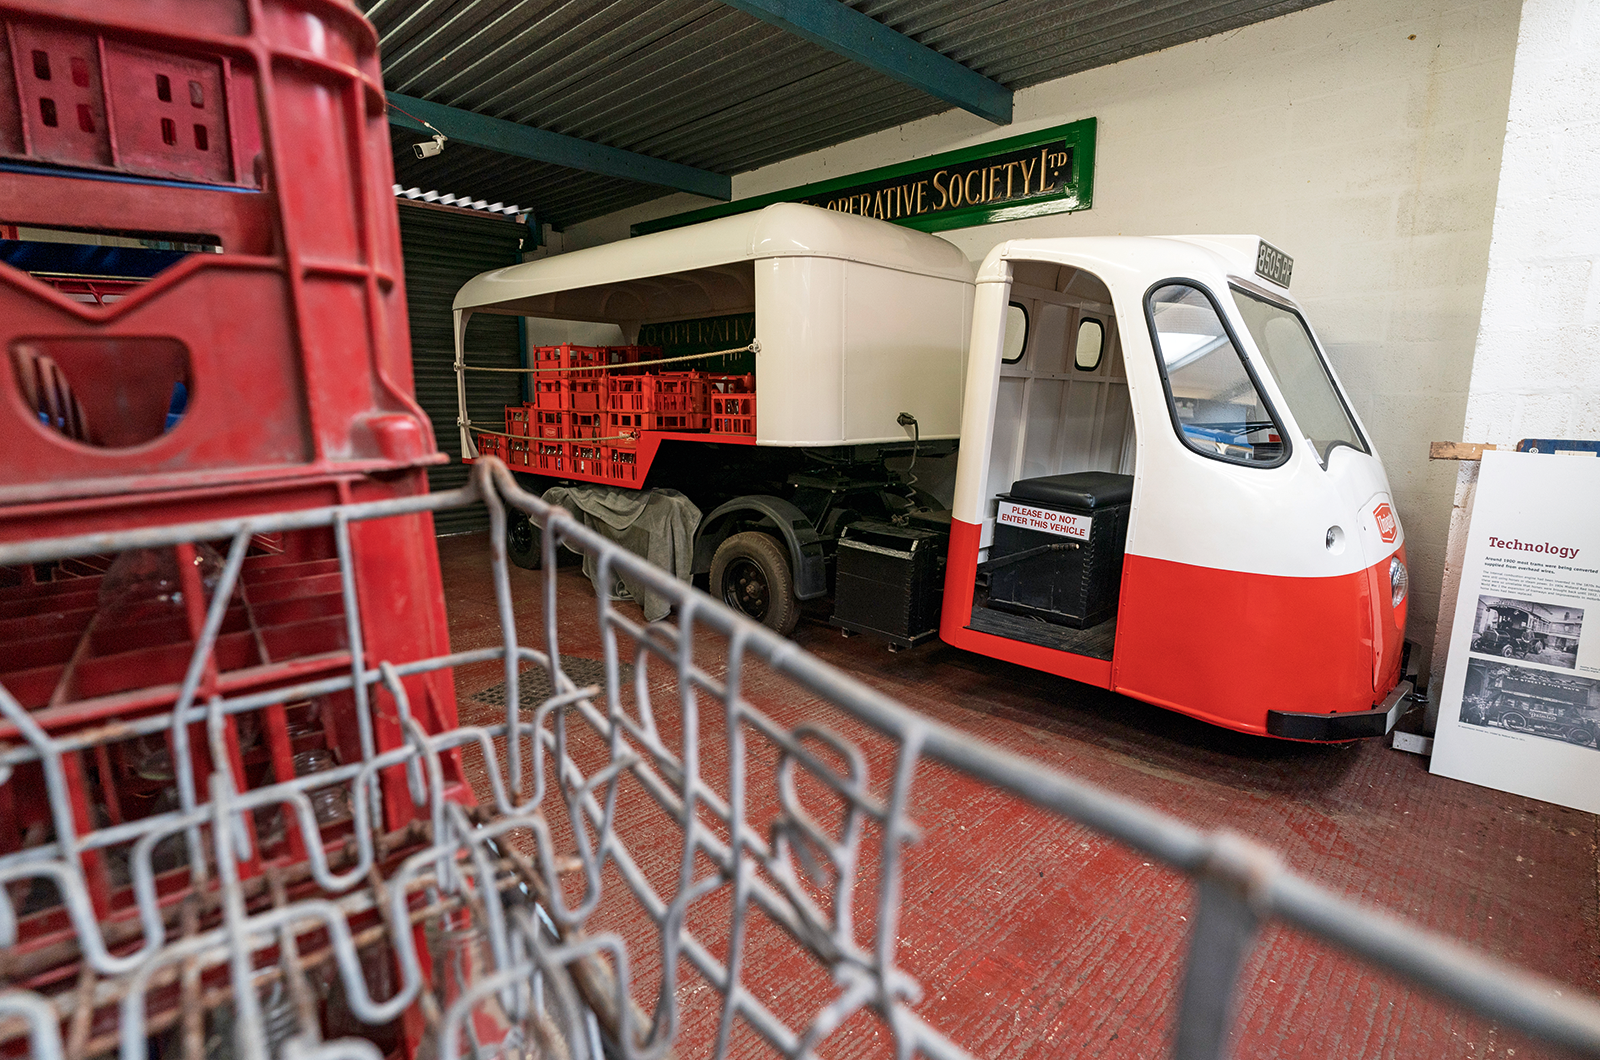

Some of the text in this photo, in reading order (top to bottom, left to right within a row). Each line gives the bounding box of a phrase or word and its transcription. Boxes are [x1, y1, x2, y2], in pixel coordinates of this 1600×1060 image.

[932, 157, 1038, 210] SOCIETY
[1259, 244, 1281, 279] 8505
[1002, 514, 1086, 536] ENTER THIS VEHICLE
[1012, 506, 1077, 525] PLEASE DO NOT
[1489, 536, 1580, 559] Technology
